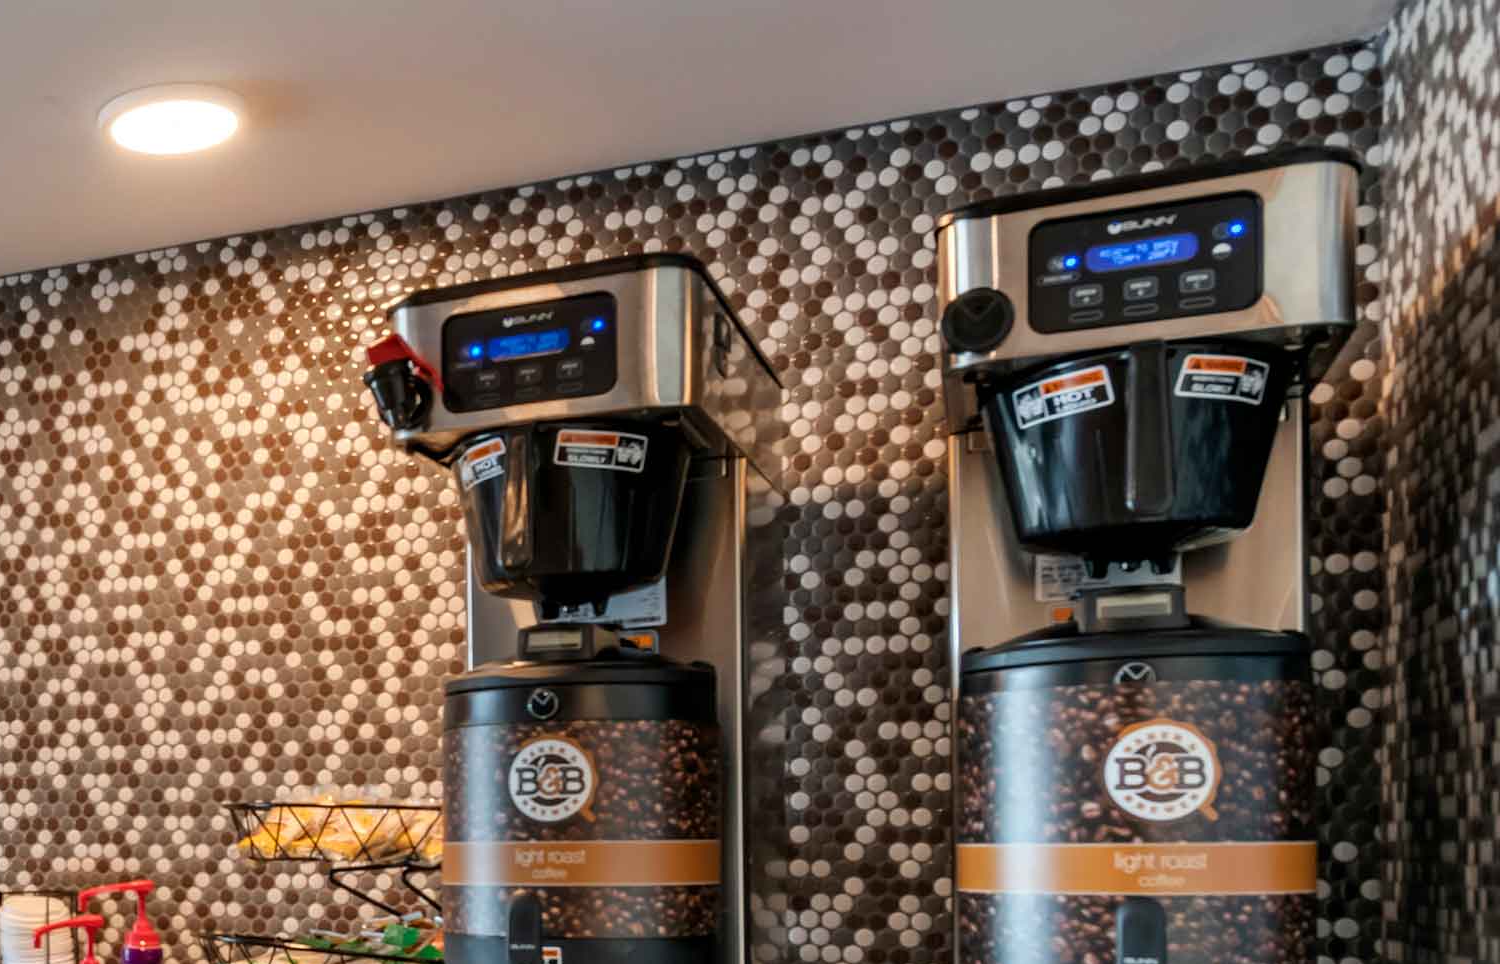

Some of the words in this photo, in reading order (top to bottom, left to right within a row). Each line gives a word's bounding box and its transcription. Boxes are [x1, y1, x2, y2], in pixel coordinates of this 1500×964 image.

[1053, 385, 1094, 405] HOT
[515, 766, 585, 796] B&B
[1115, 752, 1206, 791] B&B
[515, 849, 545, 868] light
[548, 849, 586, 865] roast
[1113, 851, 1156, 873] light
[1160, 852, 1208, 869] roast
[1138, 874, 1187, 887] coffee
